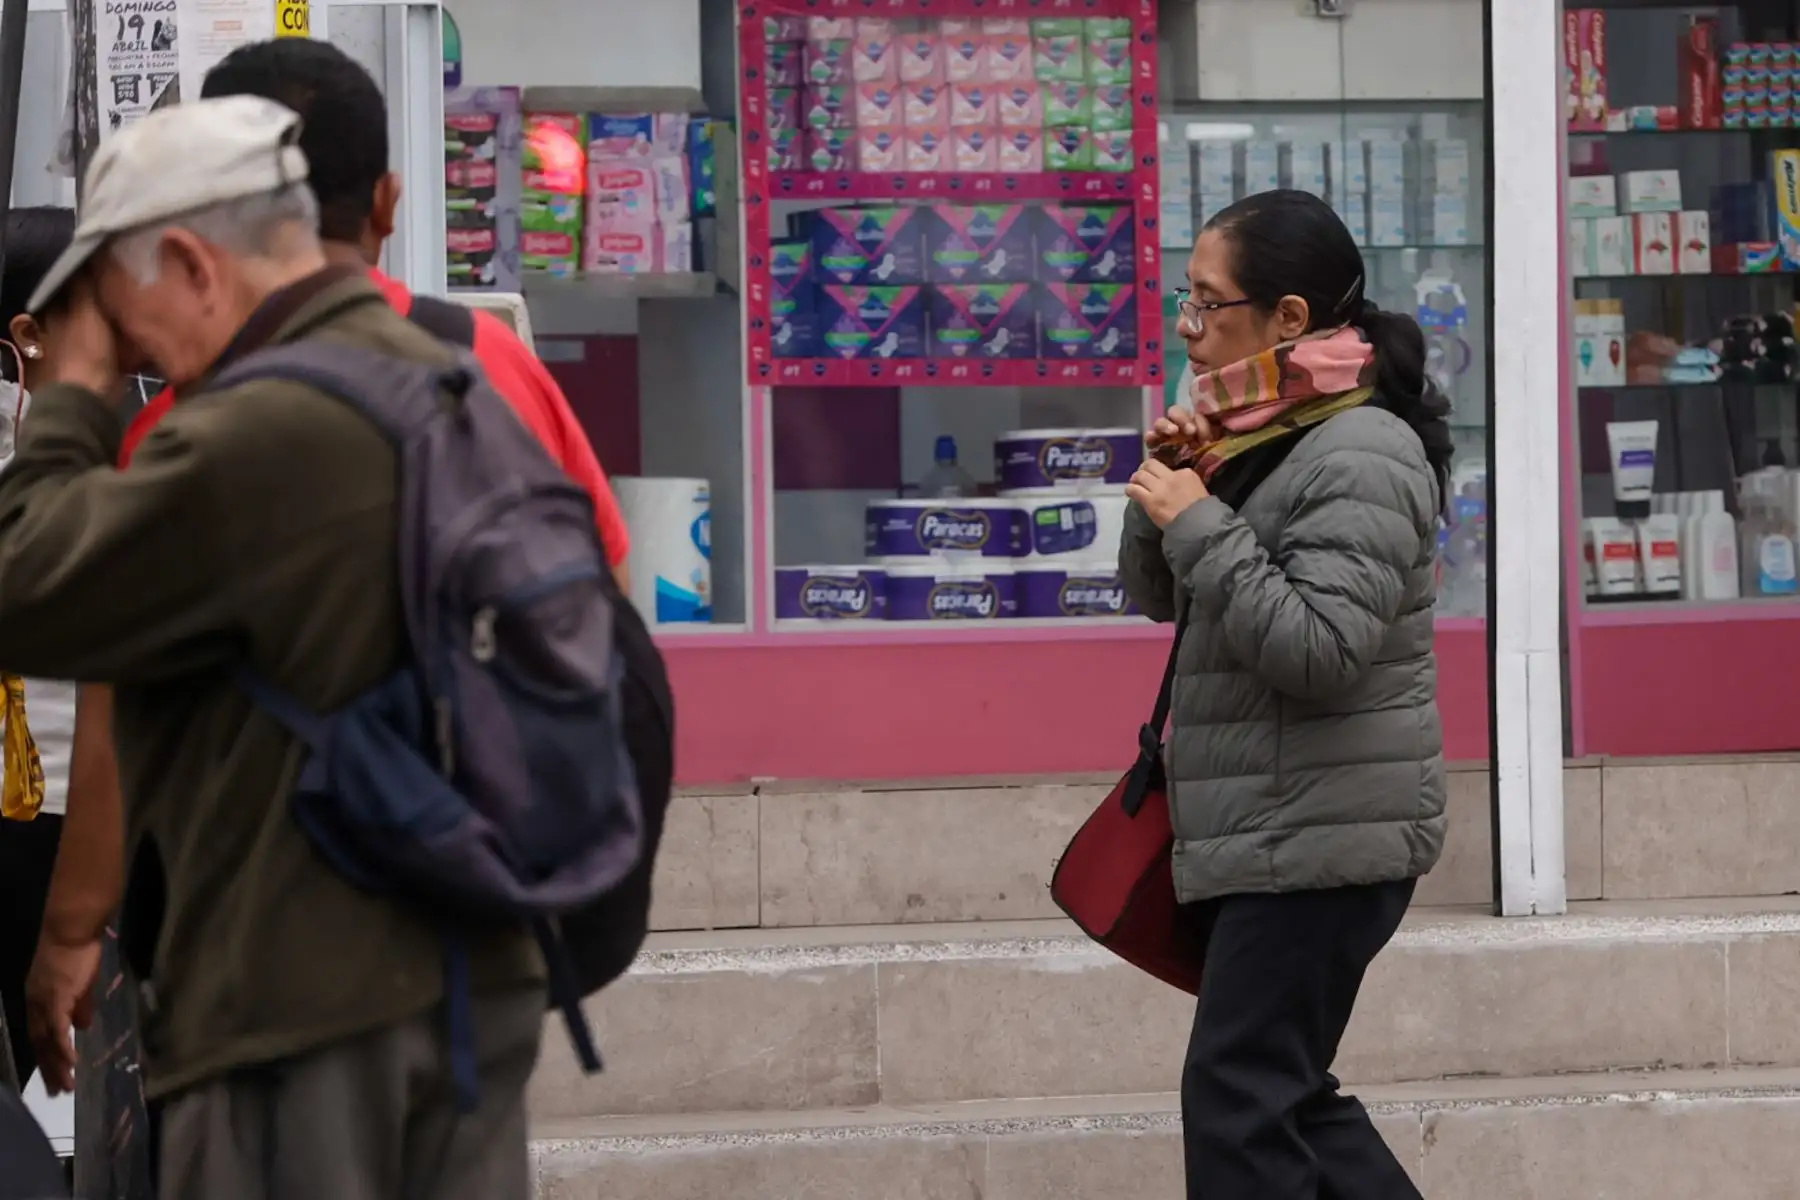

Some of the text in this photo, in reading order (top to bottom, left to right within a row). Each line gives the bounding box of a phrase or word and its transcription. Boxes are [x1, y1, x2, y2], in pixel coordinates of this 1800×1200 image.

[106, 1, 176, 14] DOMINGO
[117, 14, 145, 41] 19
[112, 41, 148, 52] ABRIL
[1046, 446, 1106, 467] Paracas
[922, 515, 985, 538] Paracas
[806, 587, 866, 610] Paracas
[933, 591, 993, 615] Paracas
[1065, 586, 1125, 611] Paracas
